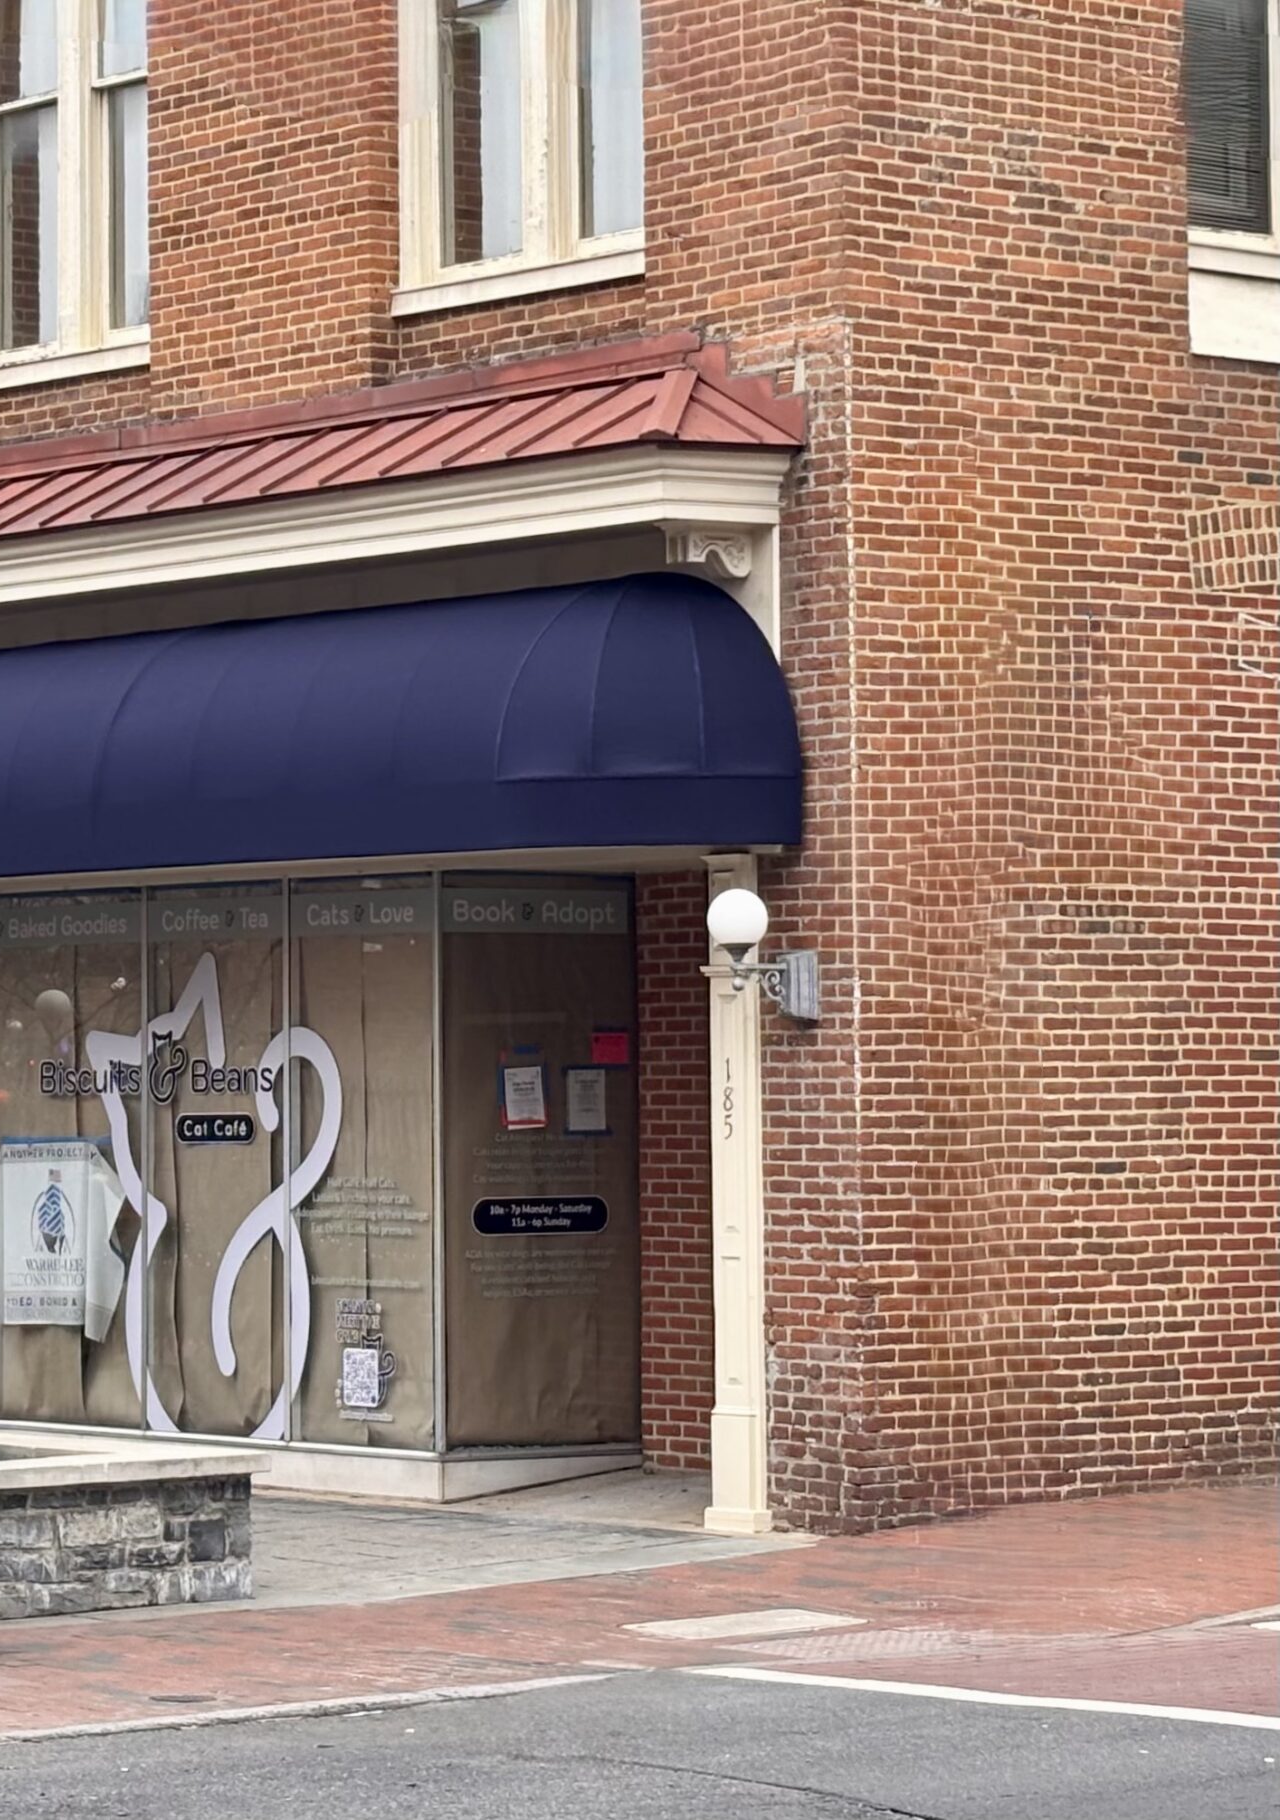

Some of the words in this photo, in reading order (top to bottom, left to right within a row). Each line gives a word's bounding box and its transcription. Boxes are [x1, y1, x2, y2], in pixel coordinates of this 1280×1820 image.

[7, 917, 57, 939] Baked
[60, 913, 128, 936] Goodies
[161, 908, 220, 932] Coffee
[239, 907, 269, 929] Tea
[306, 903, 350, 927] Cats
[370, 903, 415, 924] Love
[452, 898, 515, 922] Book
[541, 900, 616, 932] Adopt
[39, 1058, 142, 1095] Biscuits
[190, 1059, 274, 1093] Beans
[723, 1057, 734, 1140] 185
[182, 1119, 209, 1137] Cat
[3, 1148, 43, 1159] ANOTHER
[522, 1203, 554, 1217] Monday
[558, 1202, 593, 1216] Saturday
[543, 1217, 572, 1229] Sunday
